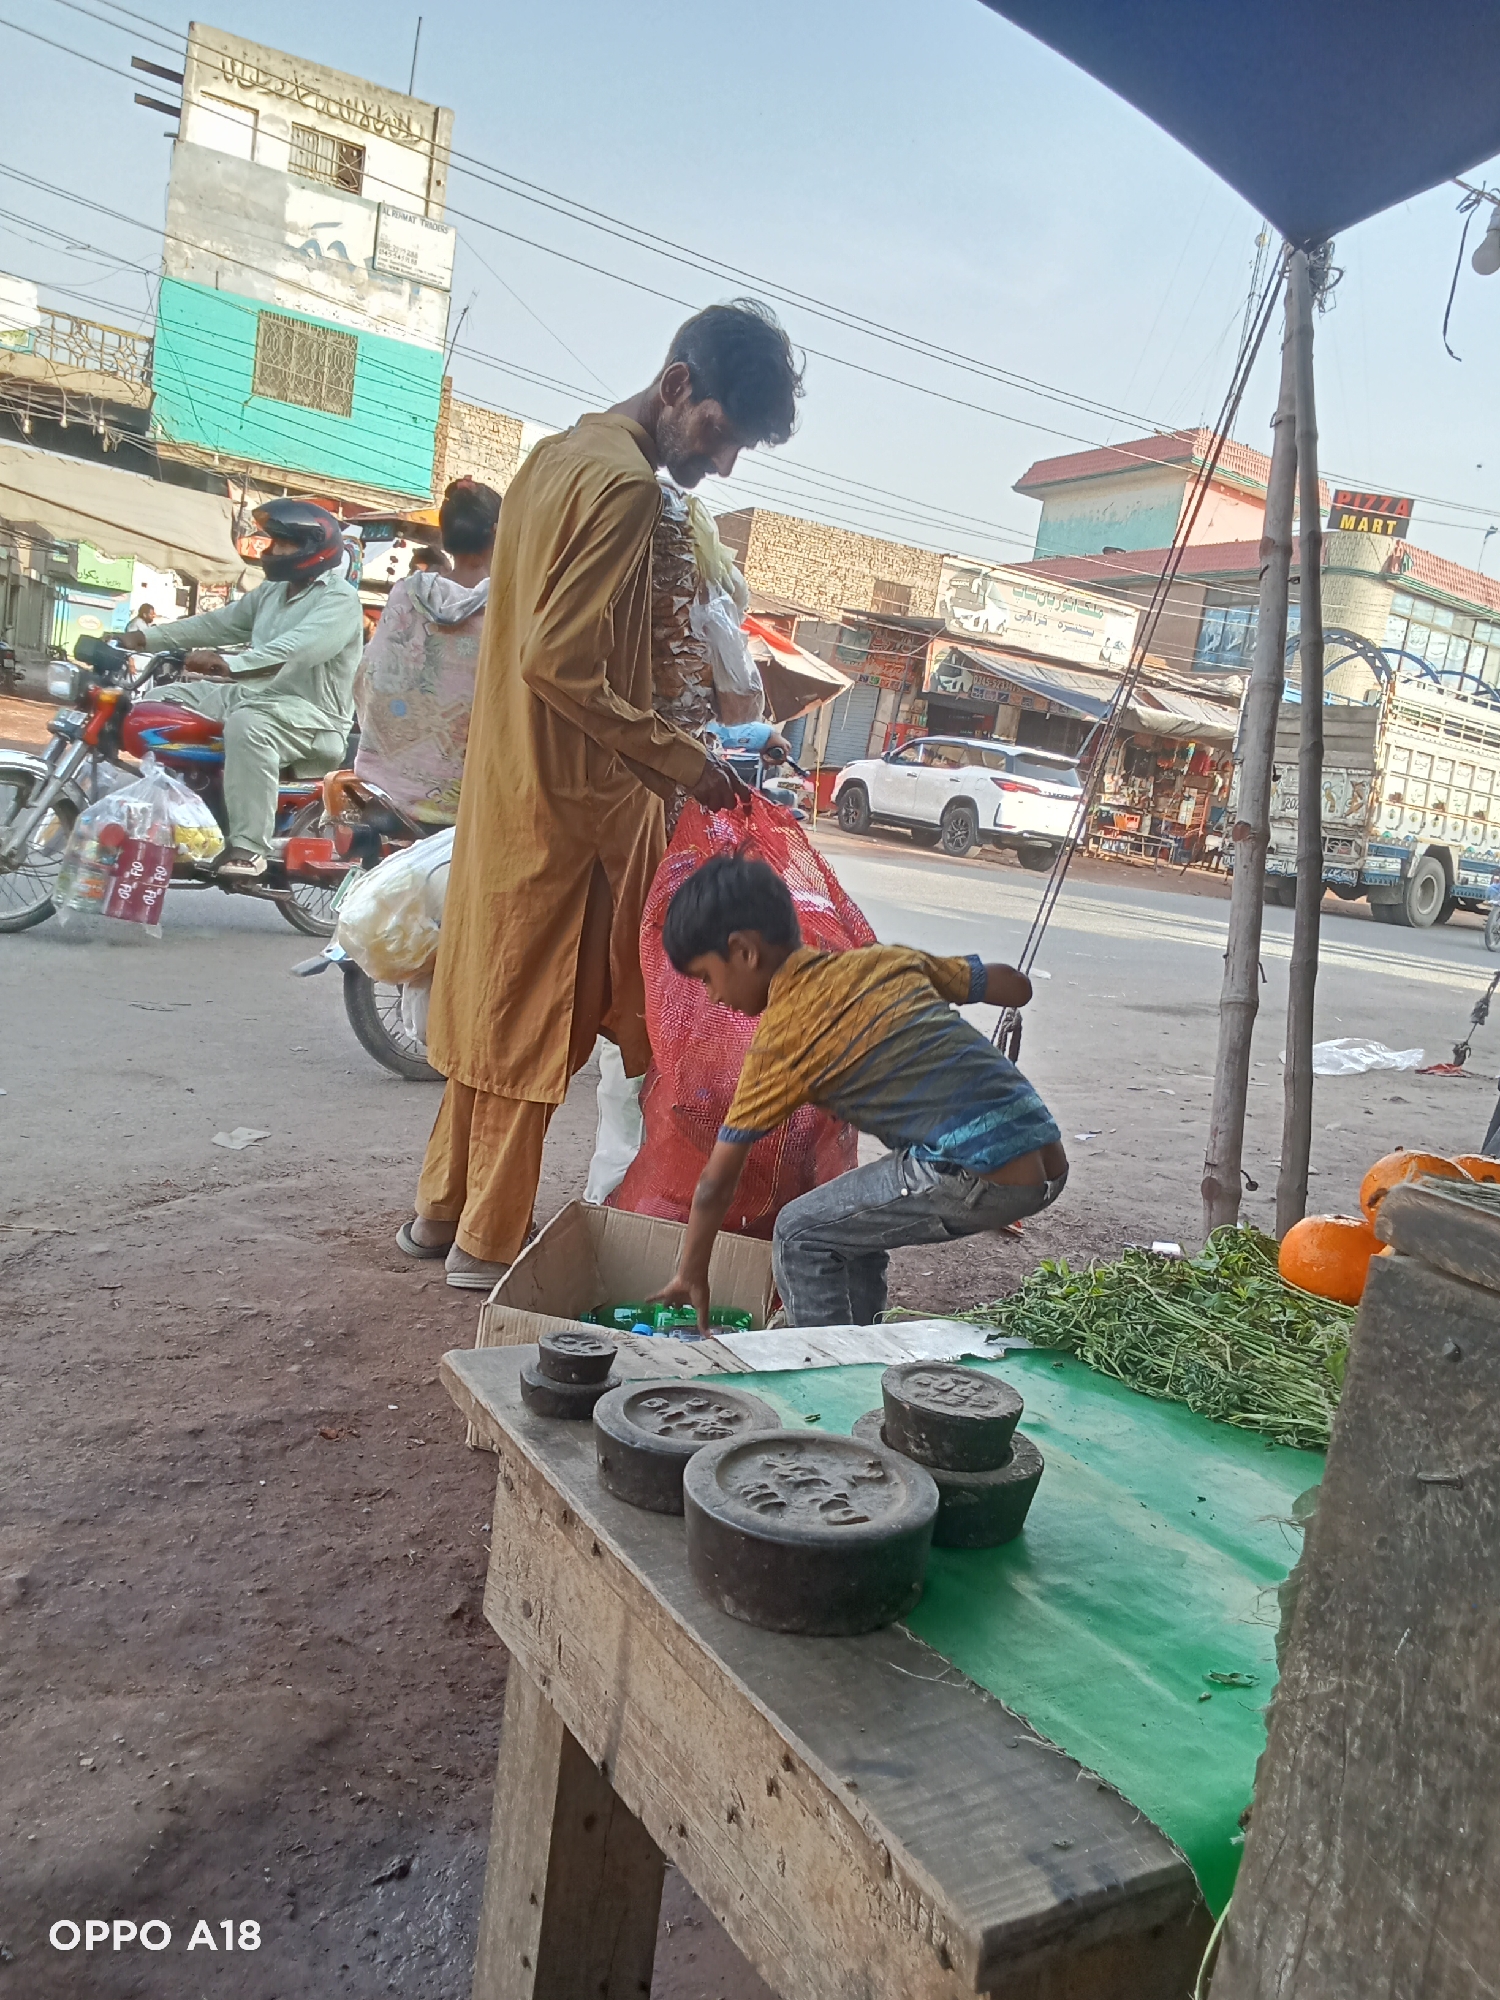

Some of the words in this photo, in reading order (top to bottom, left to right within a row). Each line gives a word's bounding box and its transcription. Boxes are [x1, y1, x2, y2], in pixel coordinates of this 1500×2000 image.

[382, 207, 391, 216] AL
[420, 218, 449, 235] TRADERS
[1335, 490, 1409, 518] PIZZA
[1340, 514, 1397, 535] MART
